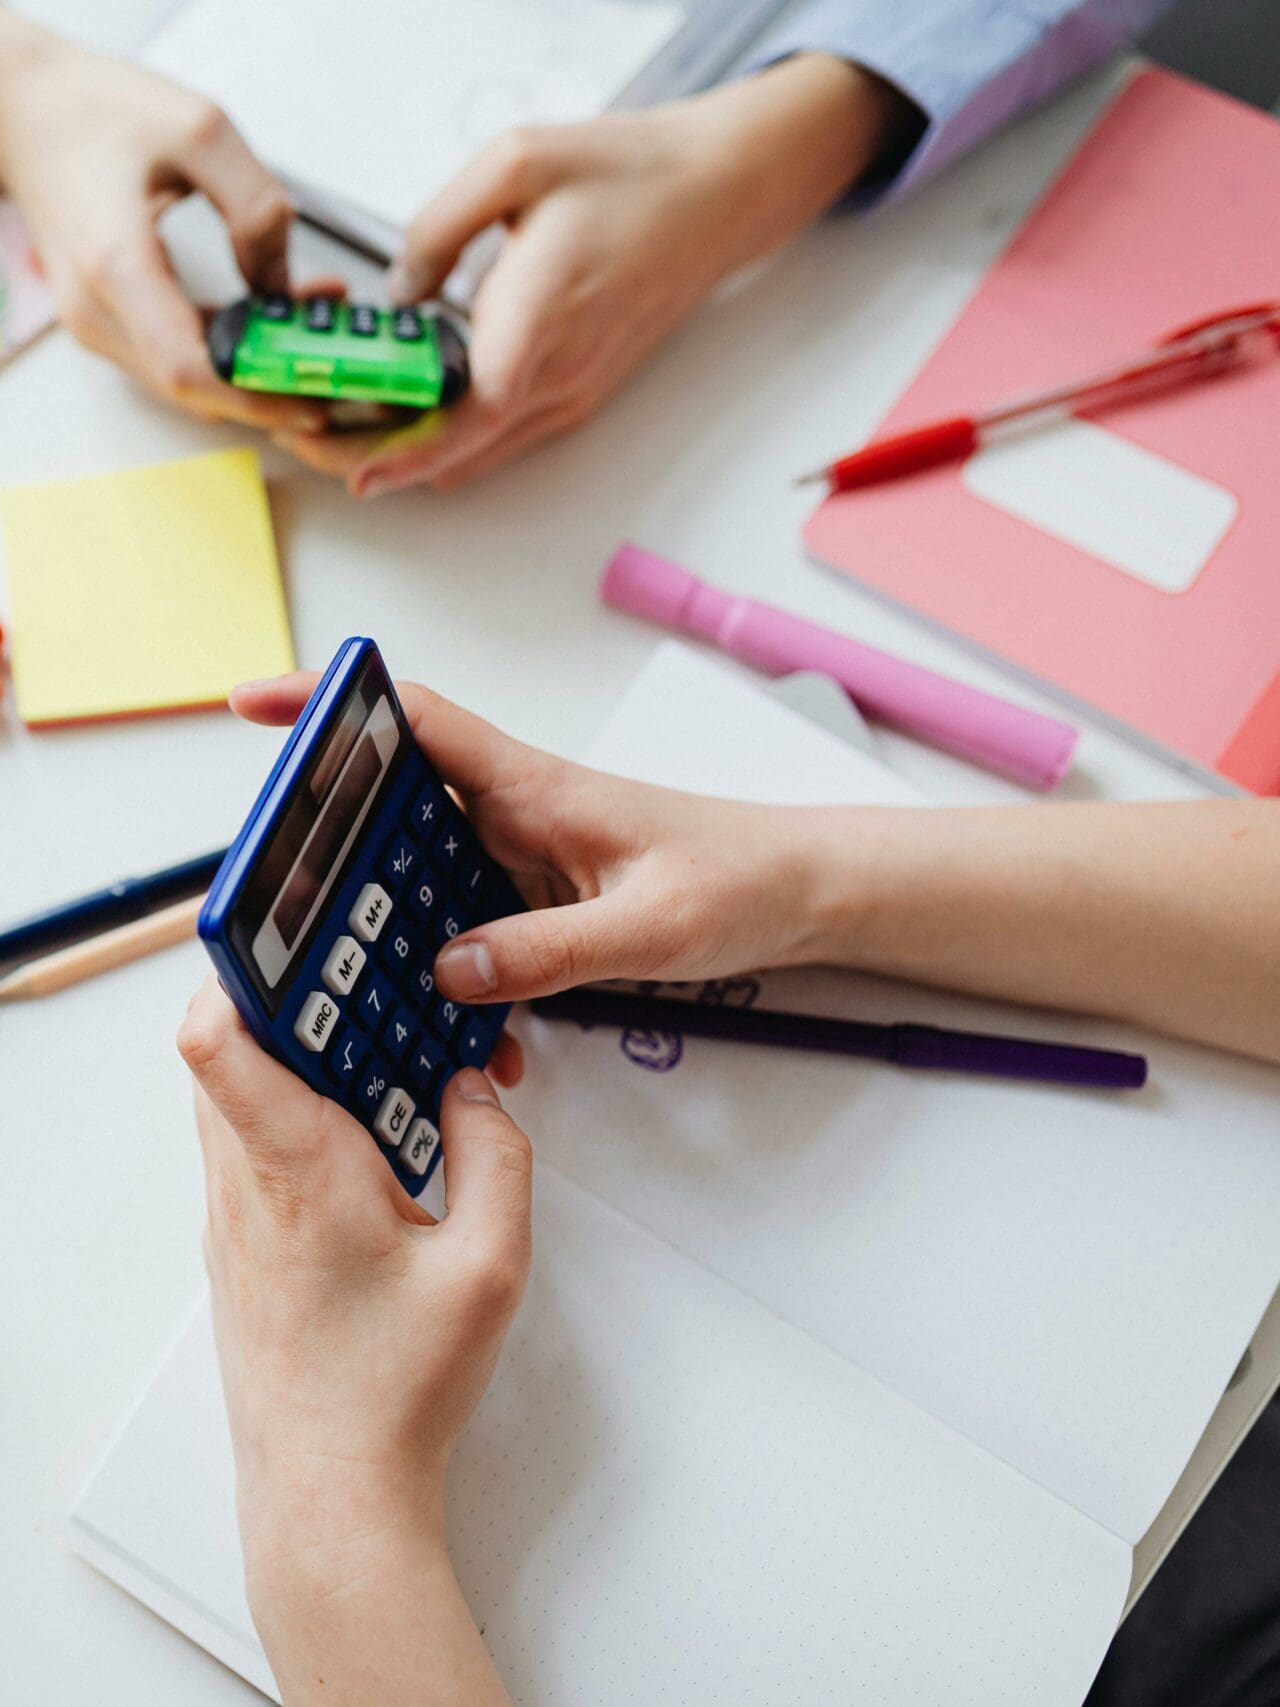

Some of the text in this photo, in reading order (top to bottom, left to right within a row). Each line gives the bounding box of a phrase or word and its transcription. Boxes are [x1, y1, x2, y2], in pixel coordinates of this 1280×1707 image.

[311, 1003, 333, 1040] MRC
[338, 951, 356, 981] M-
[365, 898, 383, 929] M+
[367, 988, 380, 1012] 7
[394, 936, 409, 958] 8
[419, 885, 433, 907] 9
[395, 1022, 407, 1042] 4
[419, 970, 433, 992] 5
[445, 917, 459, 939] 6
[389, 1001, 458, 1132] CE 1 2
